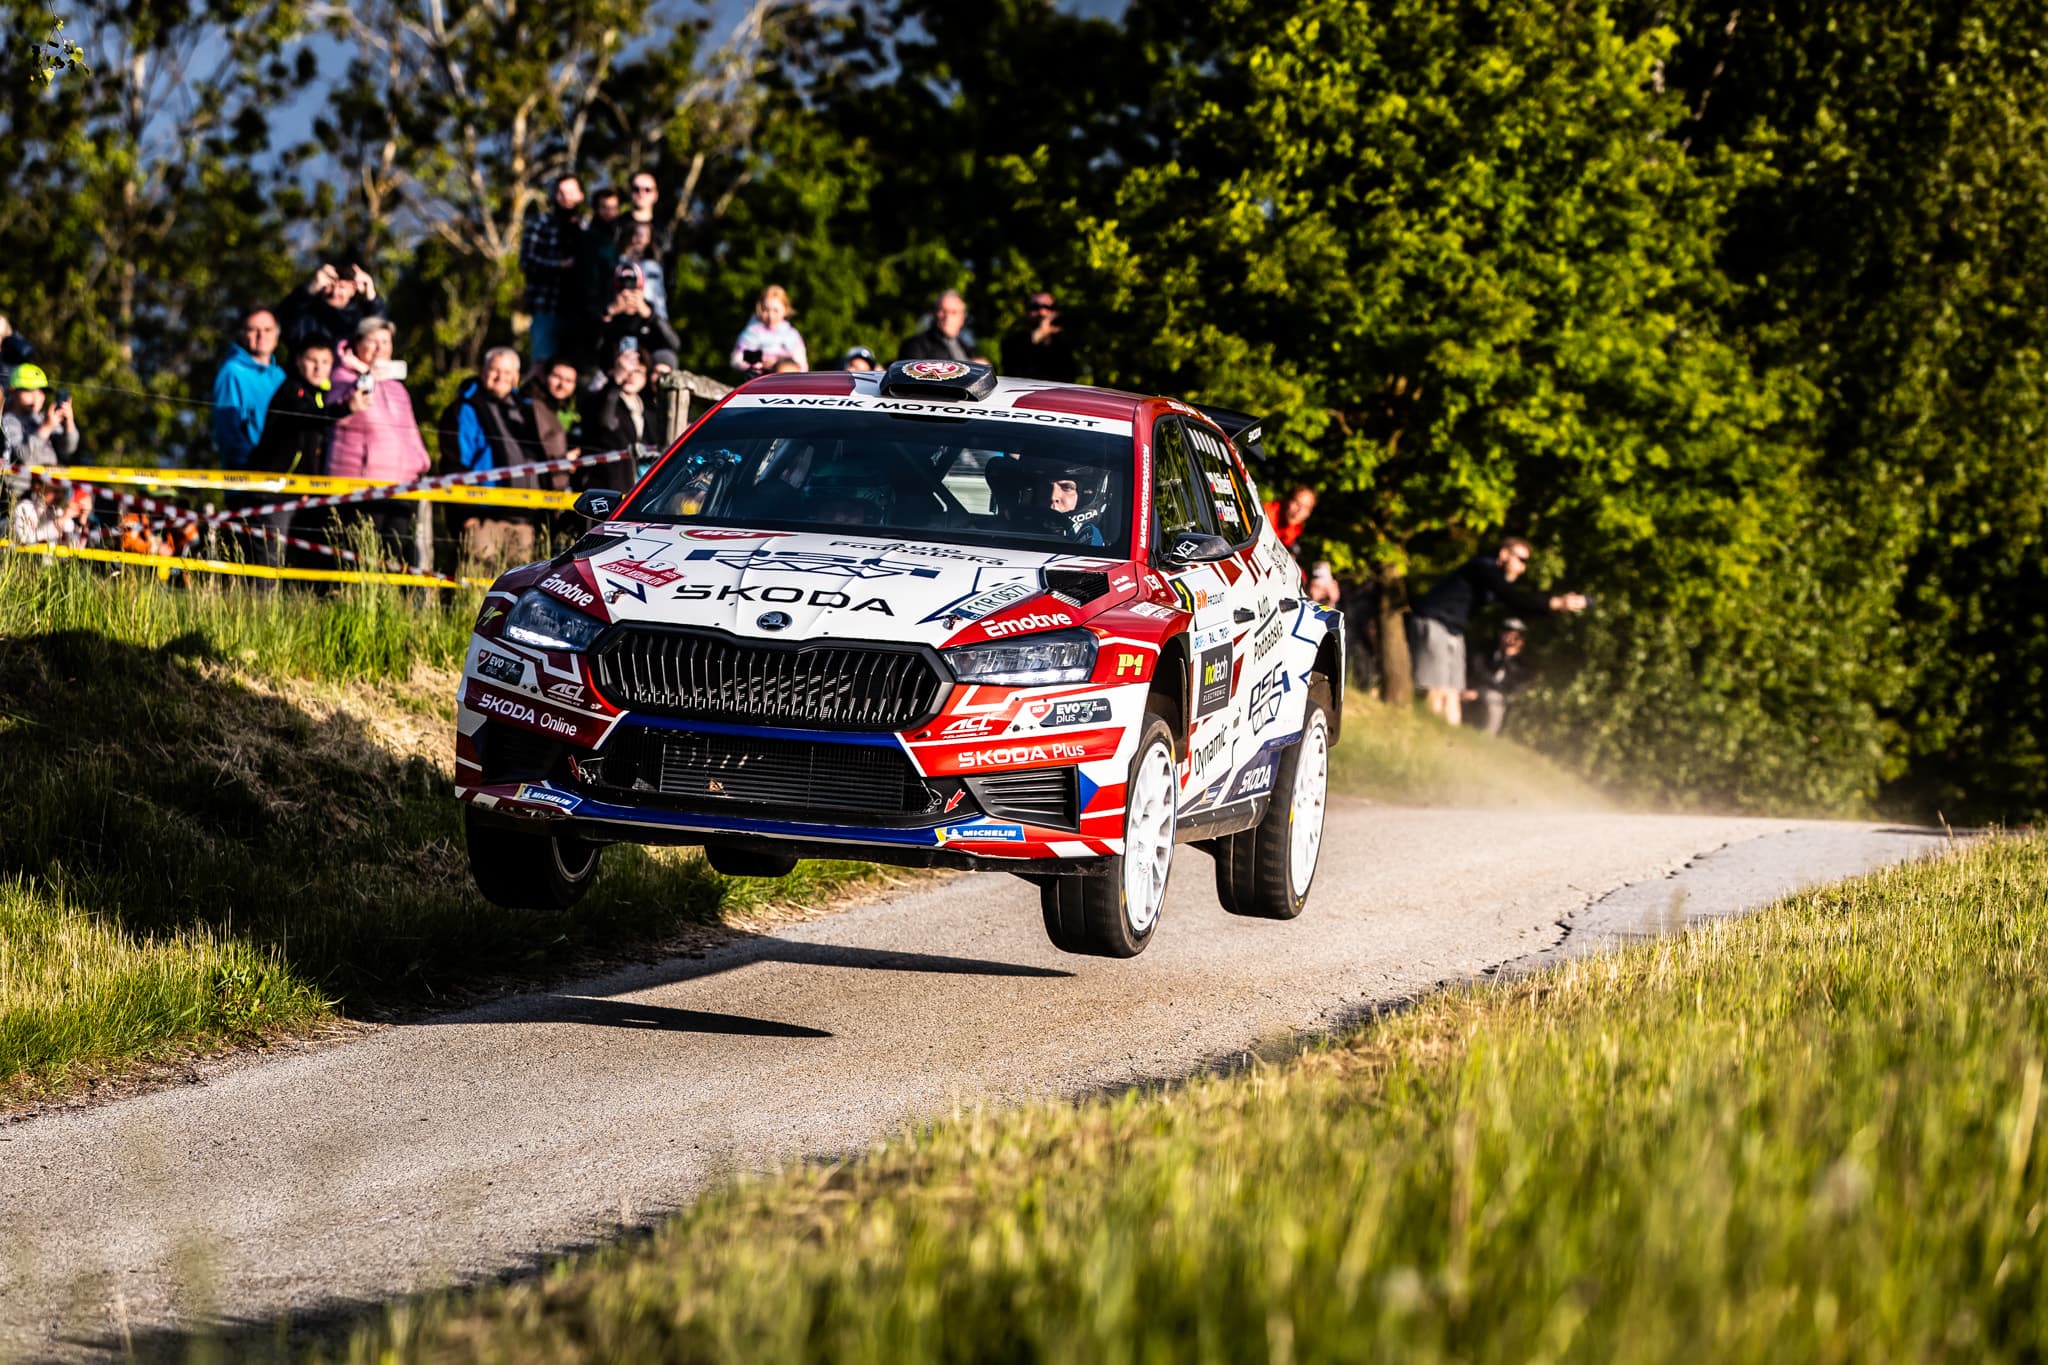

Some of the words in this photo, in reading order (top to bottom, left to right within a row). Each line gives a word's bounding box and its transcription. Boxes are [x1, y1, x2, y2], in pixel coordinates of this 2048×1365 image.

[873, 401, 1102, 428] MOTORSPORT
[981, 612, 1073, 637] Emotive
[1116, 653, 1144, 676] P1
[1056, 702, 1080, 715] EVO
[540, 712, 577, 736] Online
[1056, 712, 1076, 725] plus
[1052, 743, 1085, 758] Plus
[532, 792, 573, 806] MICHELIN
[962, 829, 1017, 837] MICHELIN
